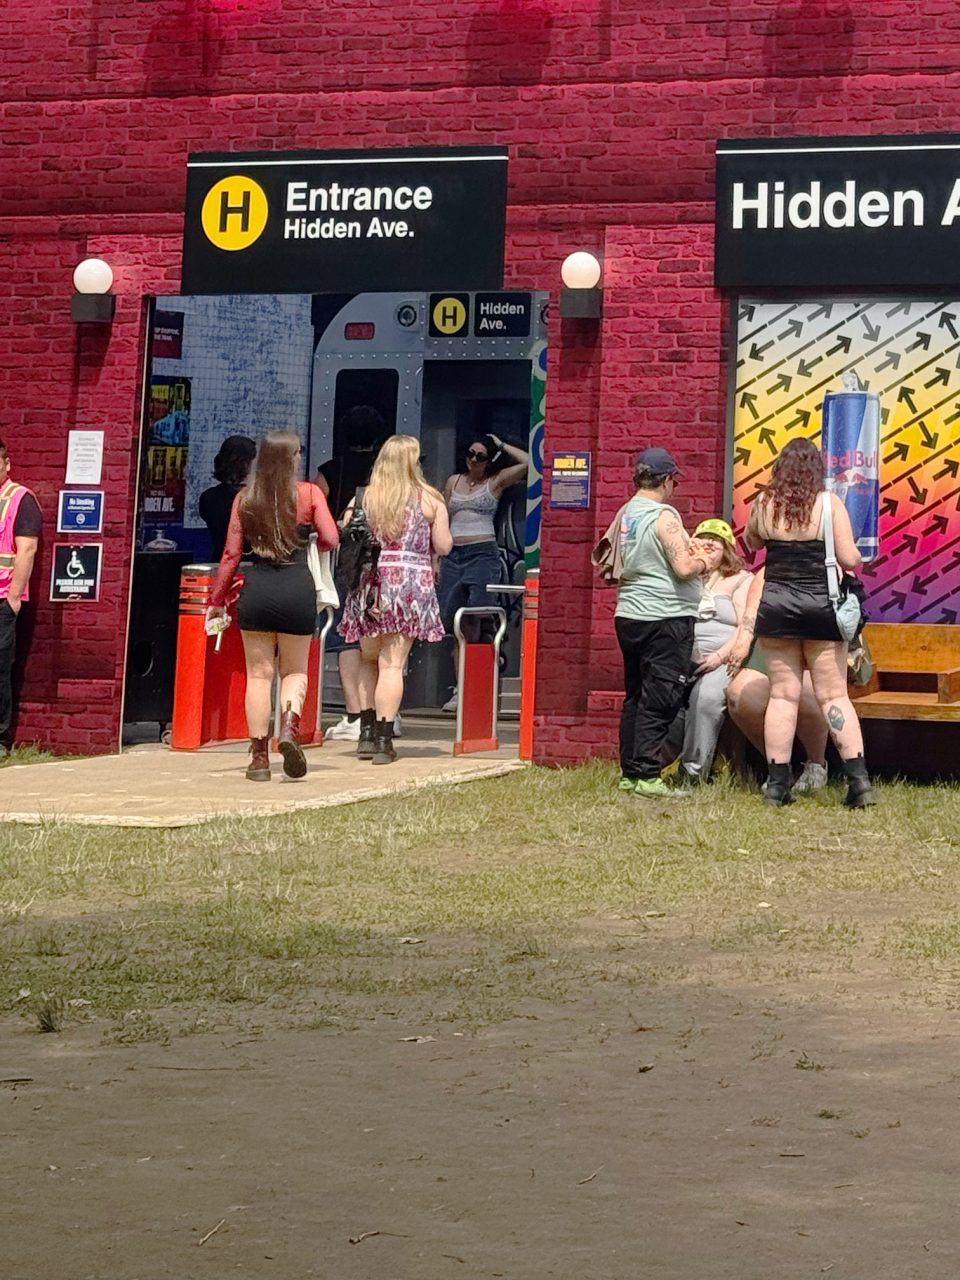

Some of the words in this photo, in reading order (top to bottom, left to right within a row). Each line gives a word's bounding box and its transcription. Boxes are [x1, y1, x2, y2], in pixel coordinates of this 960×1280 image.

[286, 182, 433, 212] Entrance
[732, 180, 924, 229] Hidden
[219, 190, 251, 233] H
[284, 218, 361, 239] Hidden
[366, 217, 415, 238] Ave.
[441, 305, 458, 327] H
[479, 302, 525, 315] Hidden
[479, 317, 507, 330] Ave.
